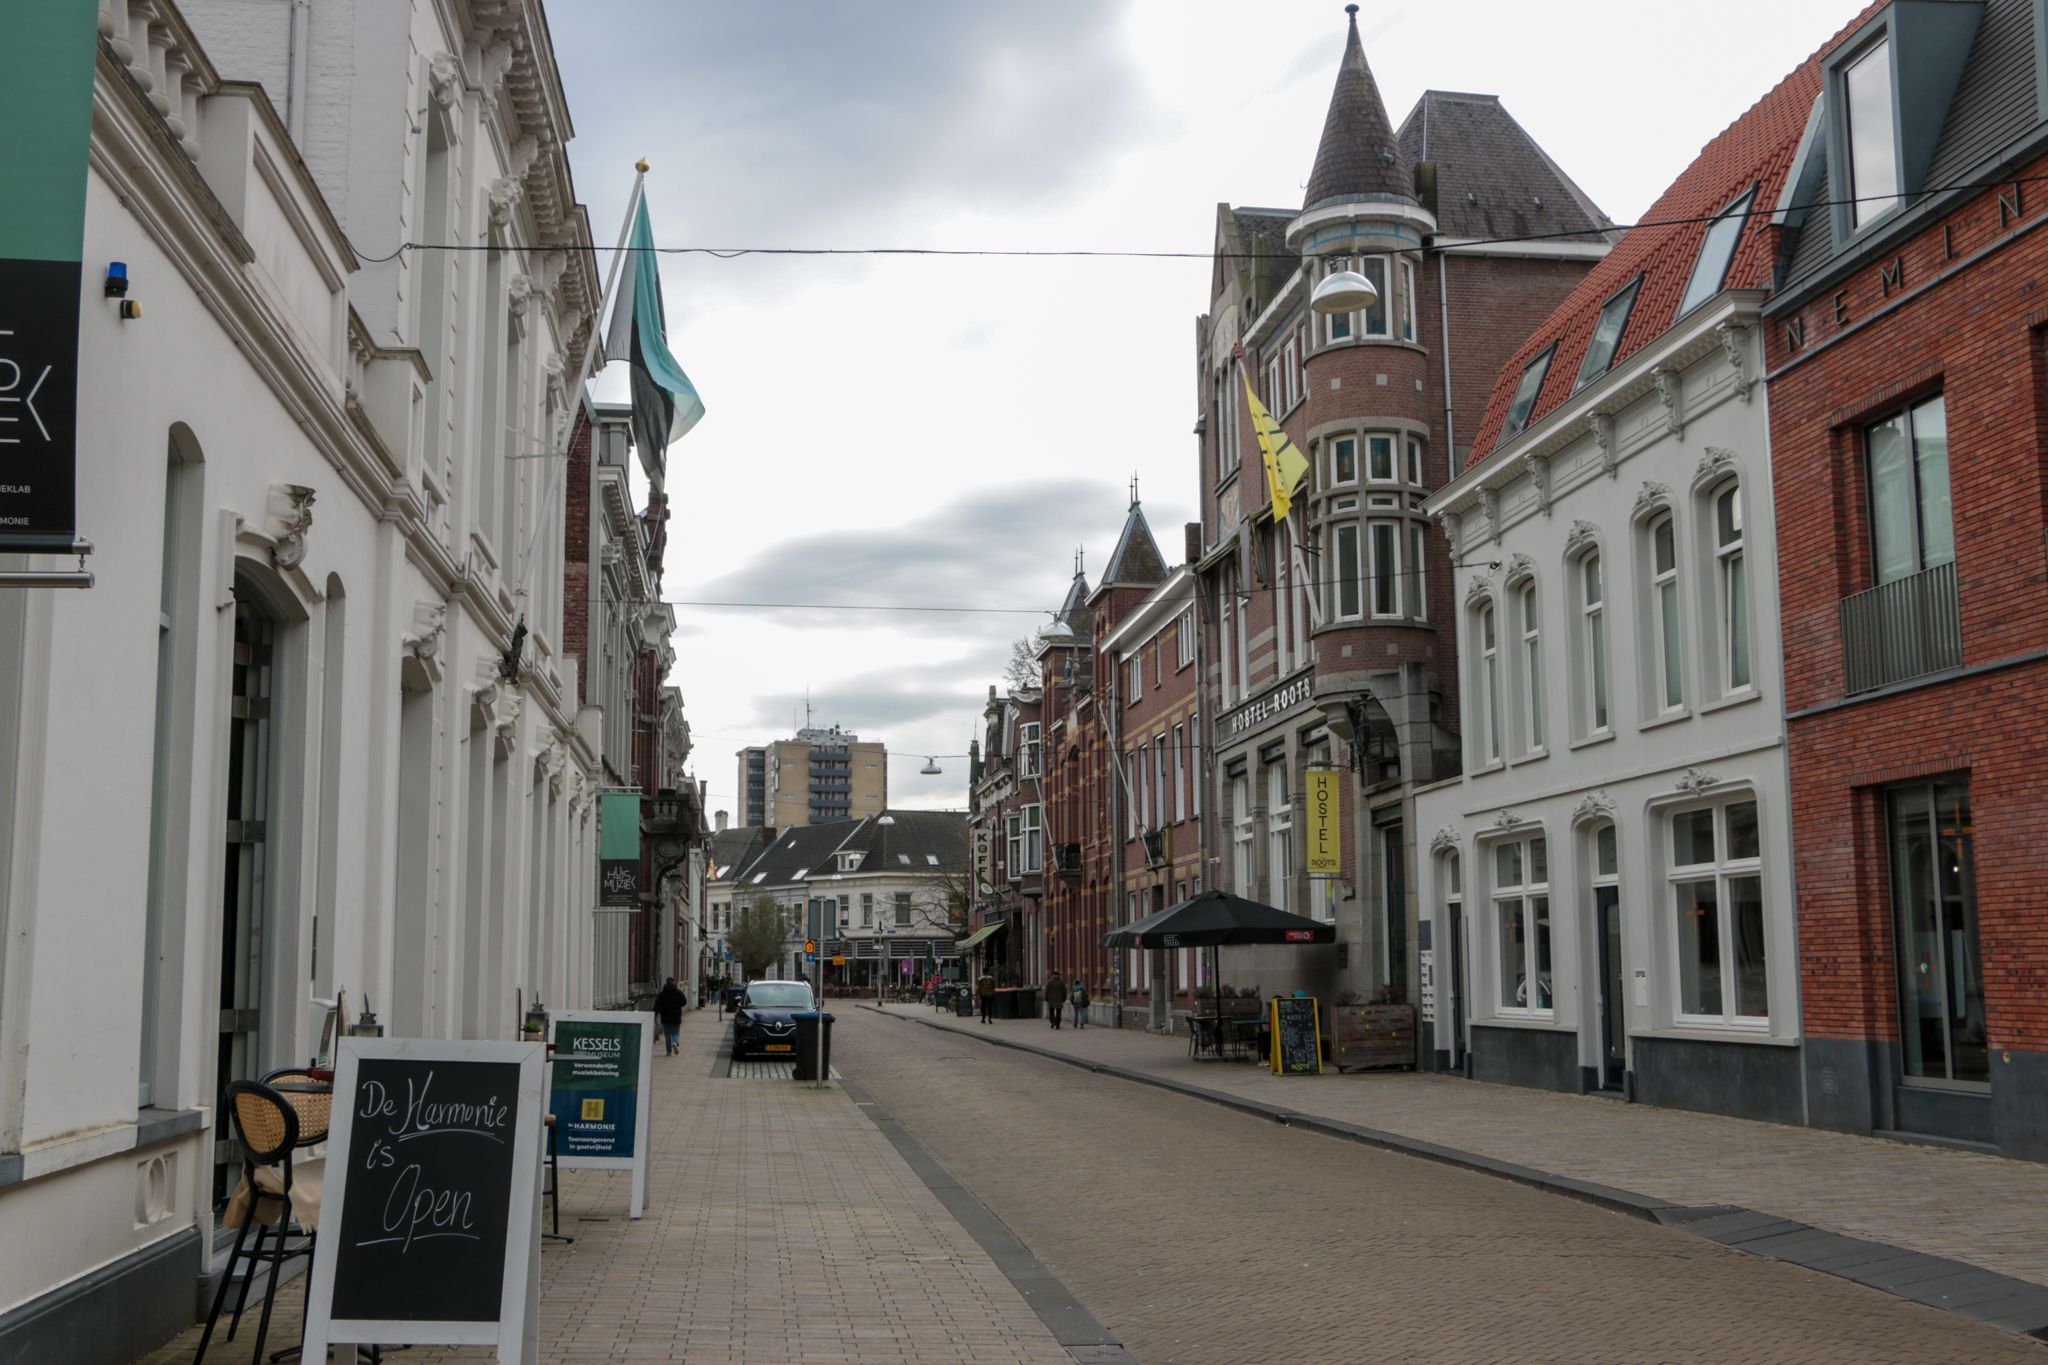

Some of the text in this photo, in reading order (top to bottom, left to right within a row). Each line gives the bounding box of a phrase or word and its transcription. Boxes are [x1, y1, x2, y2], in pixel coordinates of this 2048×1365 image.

[1231, 677, 1311, 734] HOSTEL ROOTS
[1316, 776, 1329, 854] HOSTEL
[1311, 859, 1337, 867] ROOTS
[607, 865, 631, 881] HUIS
[604, 875, 636, 893] MUZIEK
[573, 1037, 621, 1051] KESSELS
[572, 1070, 620, 1078] muziekbeleving
[574, 1062, 619, 1070] Verwonderlijke
[360, 1070, 507, 1136] De Harmonie
[574, 1123, 616, 1131] HARMONIE
[366, 1139, 395, 1169] is
[383, 1164, 474, 1253] Open
